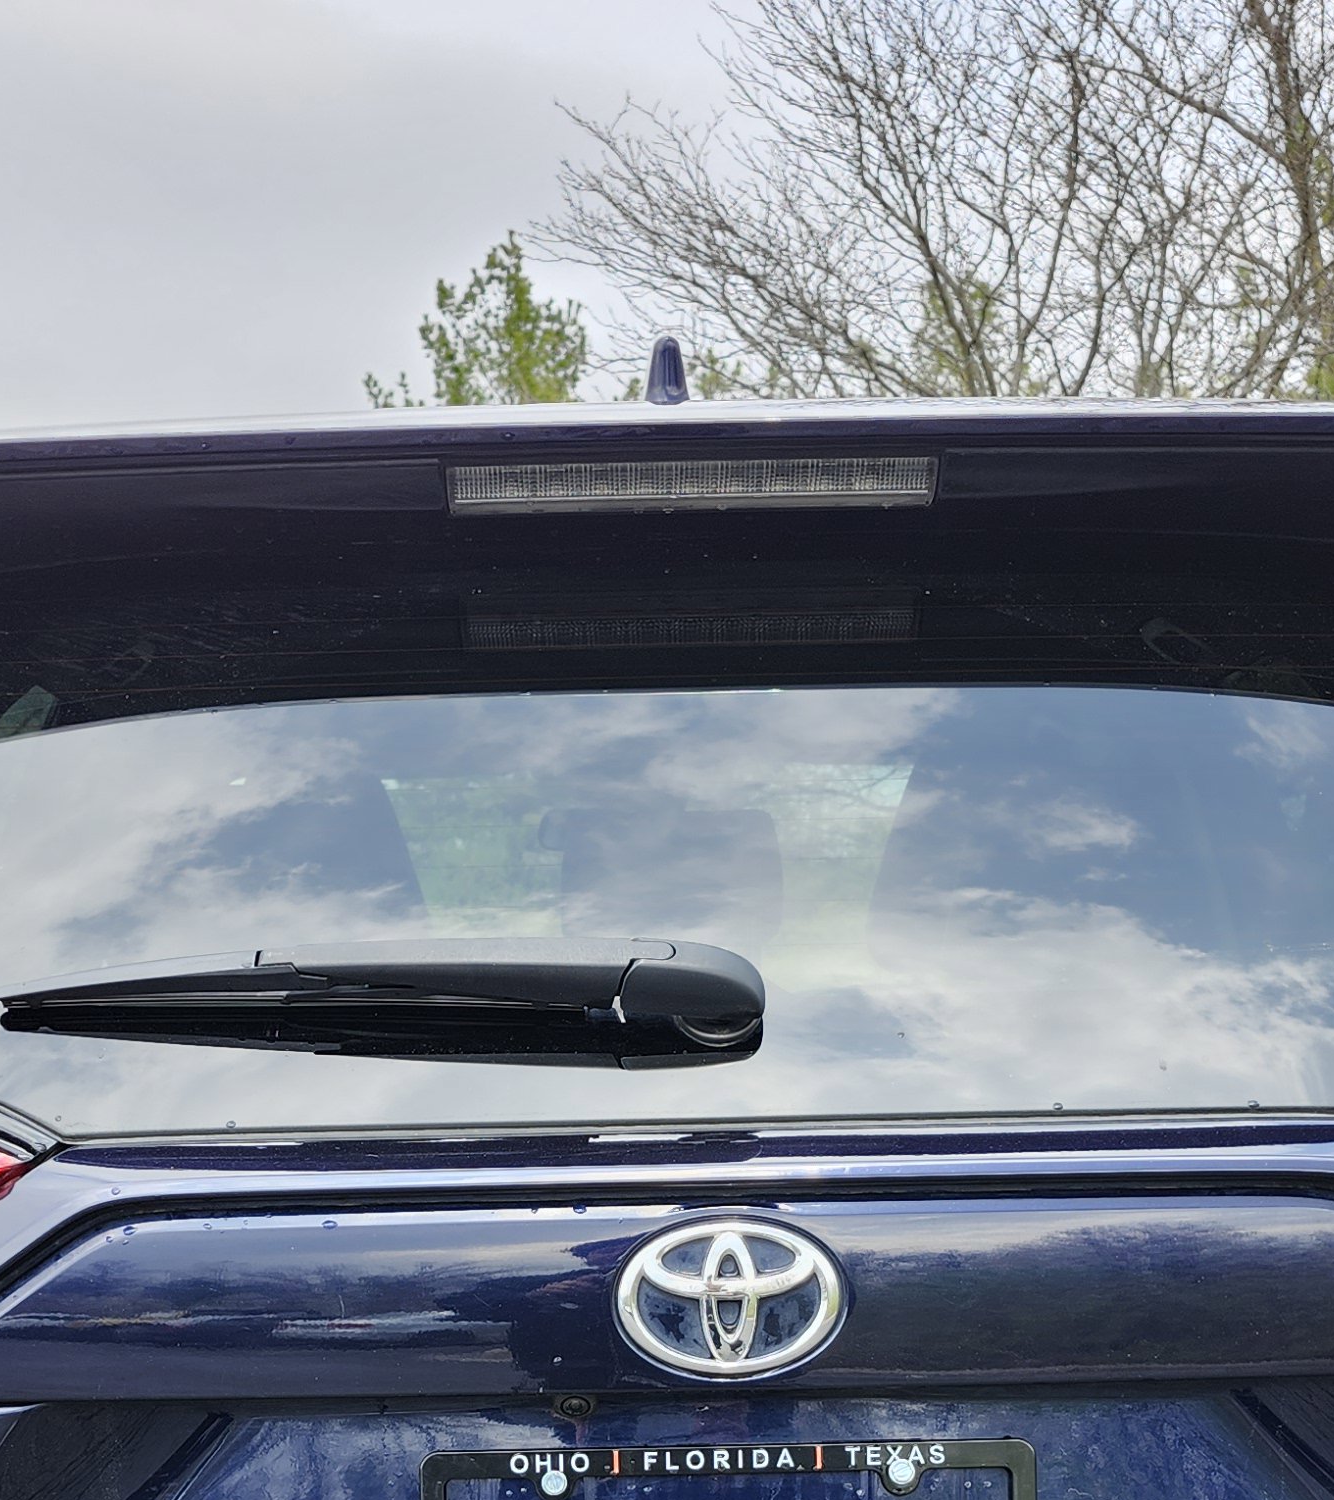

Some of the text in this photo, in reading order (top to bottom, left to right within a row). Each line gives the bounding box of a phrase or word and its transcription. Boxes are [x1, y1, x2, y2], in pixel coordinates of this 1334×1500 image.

[509, 1443, 946, 1474] OHIO FLORIDA TEXAS
